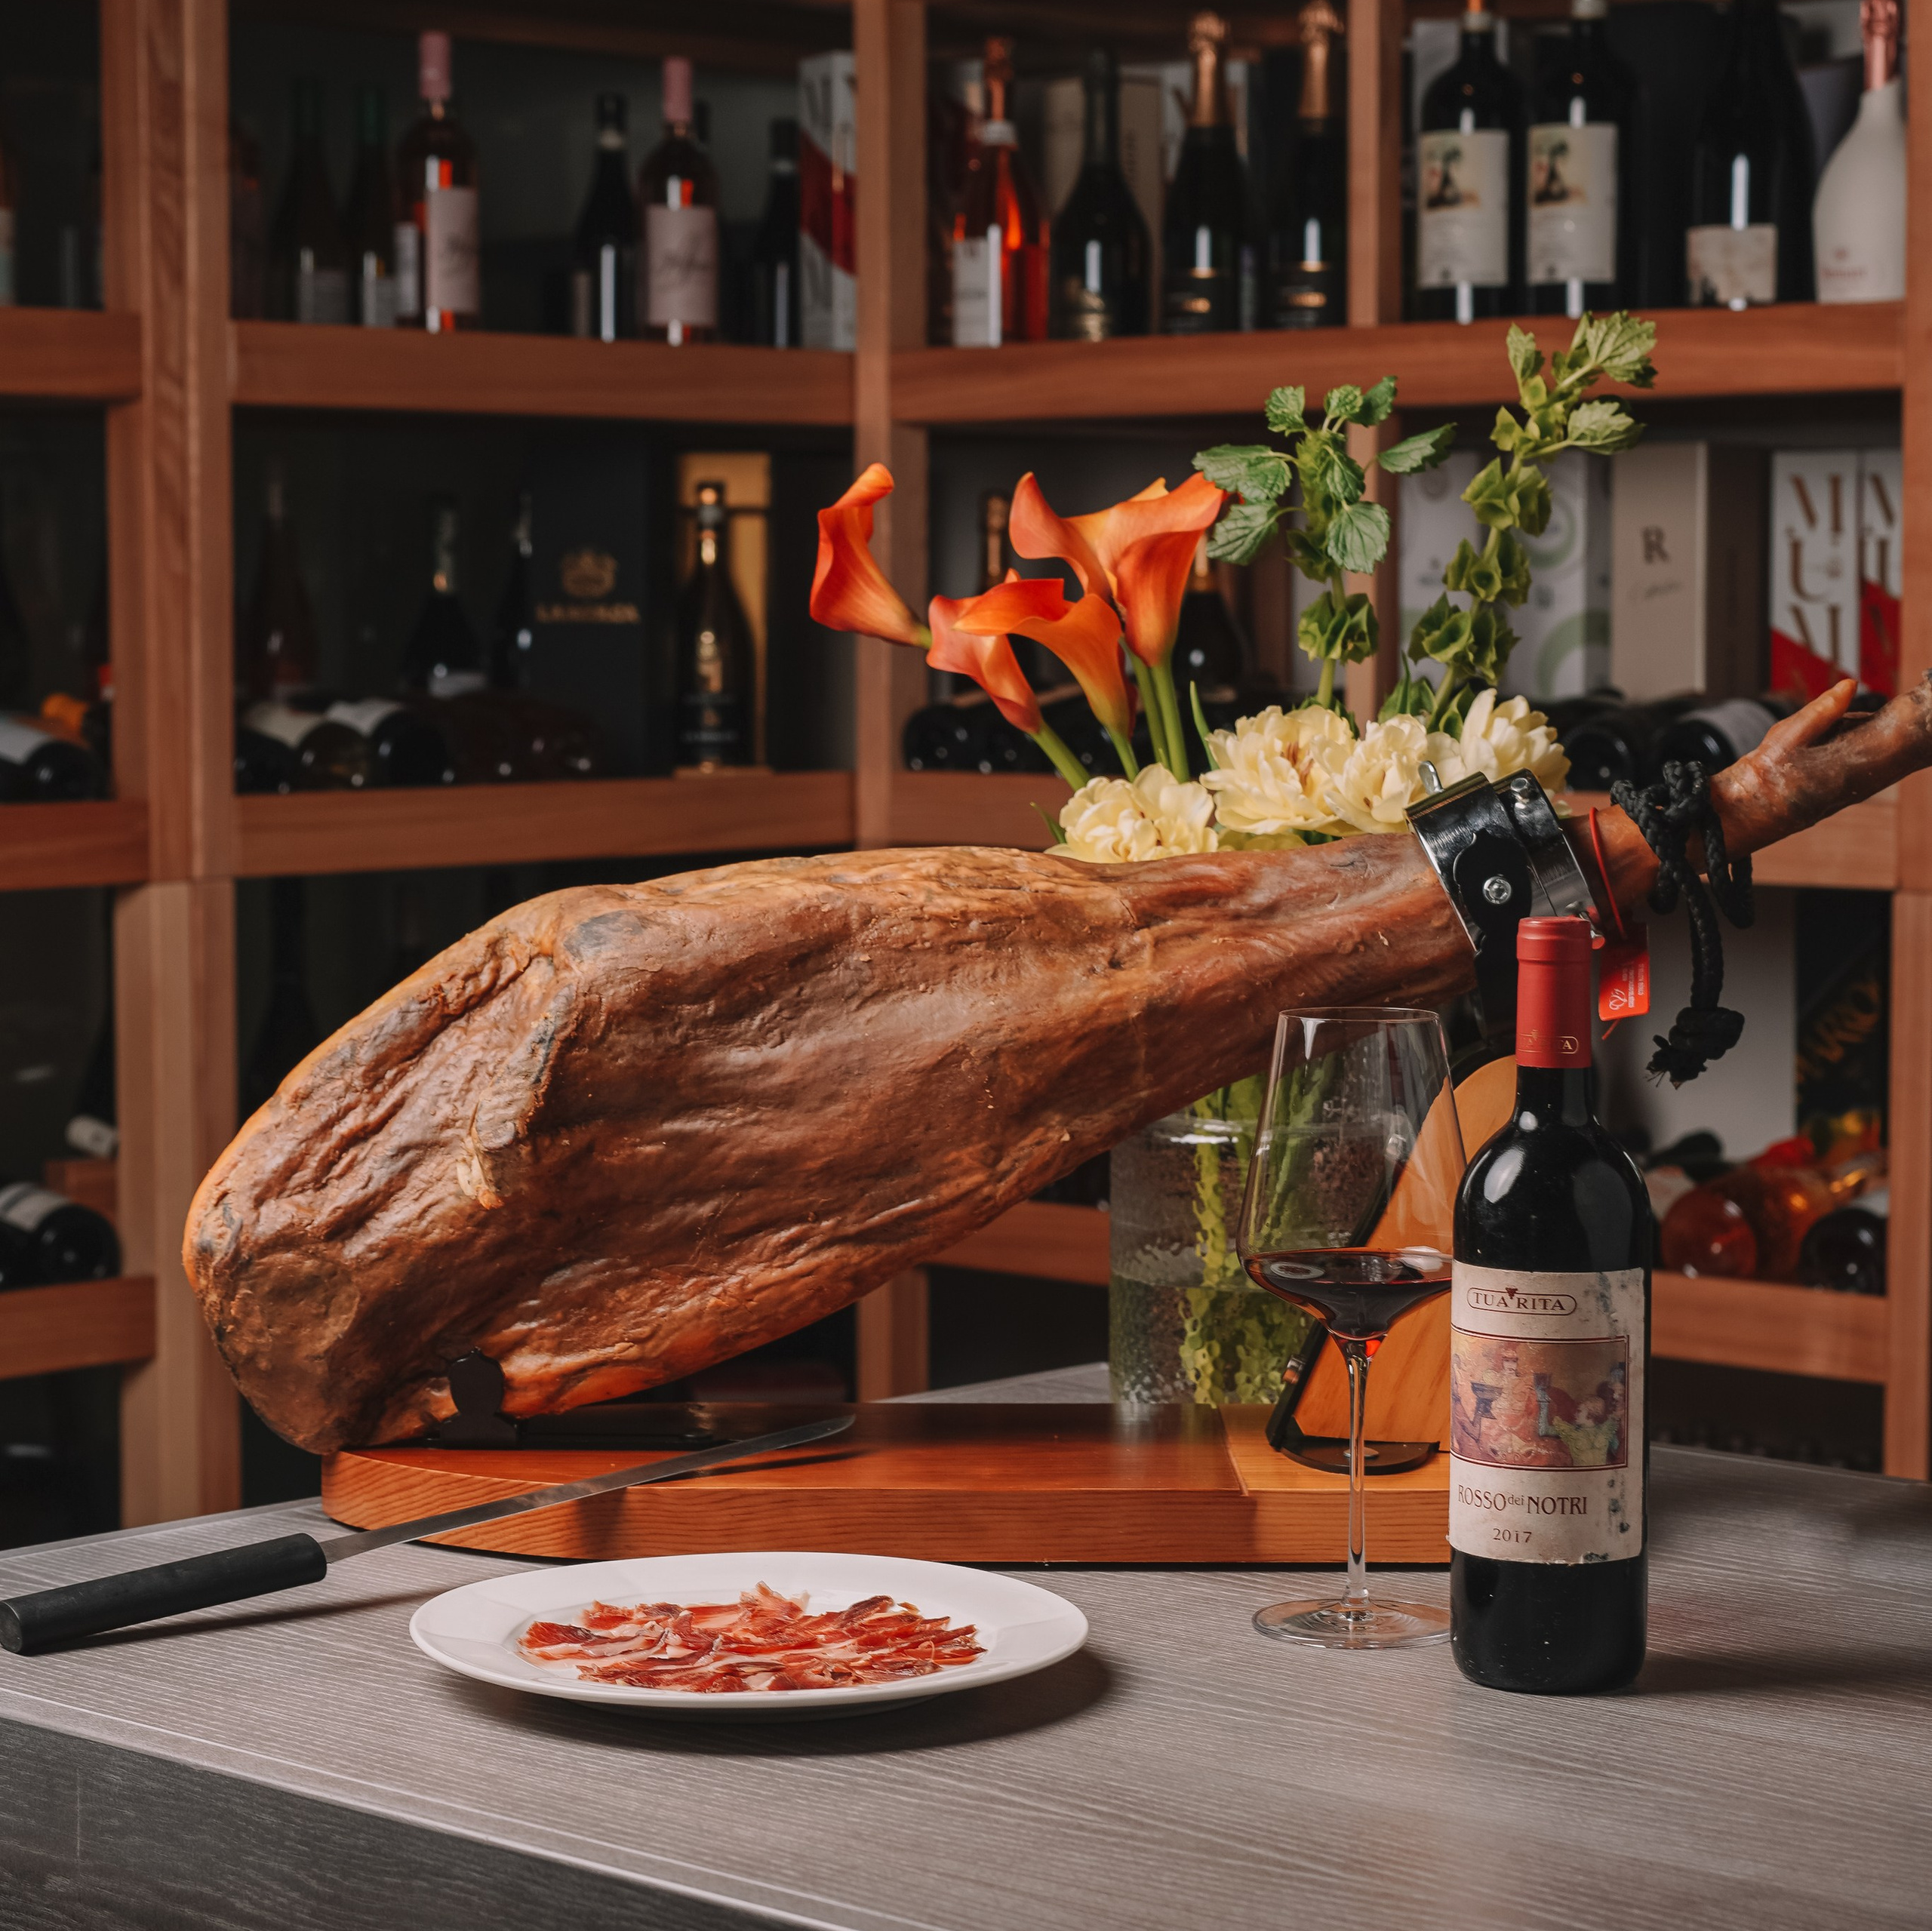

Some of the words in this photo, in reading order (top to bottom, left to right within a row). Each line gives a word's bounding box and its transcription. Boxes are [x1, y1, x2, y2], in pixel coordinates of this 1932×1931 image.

[1643, 526, 1669, 563] R
[1473, 1292, 1509, 1308] TUA
[1516, 1296, 1566, 1311] RITA
[1458, 1484, 1506, 1511] ROSSO
[1507, 1494, 1524, 1506] dei
[1527, 1496, 1587, 1515] NOTRI
[1492, 1528, 1533, 1543] 2017
